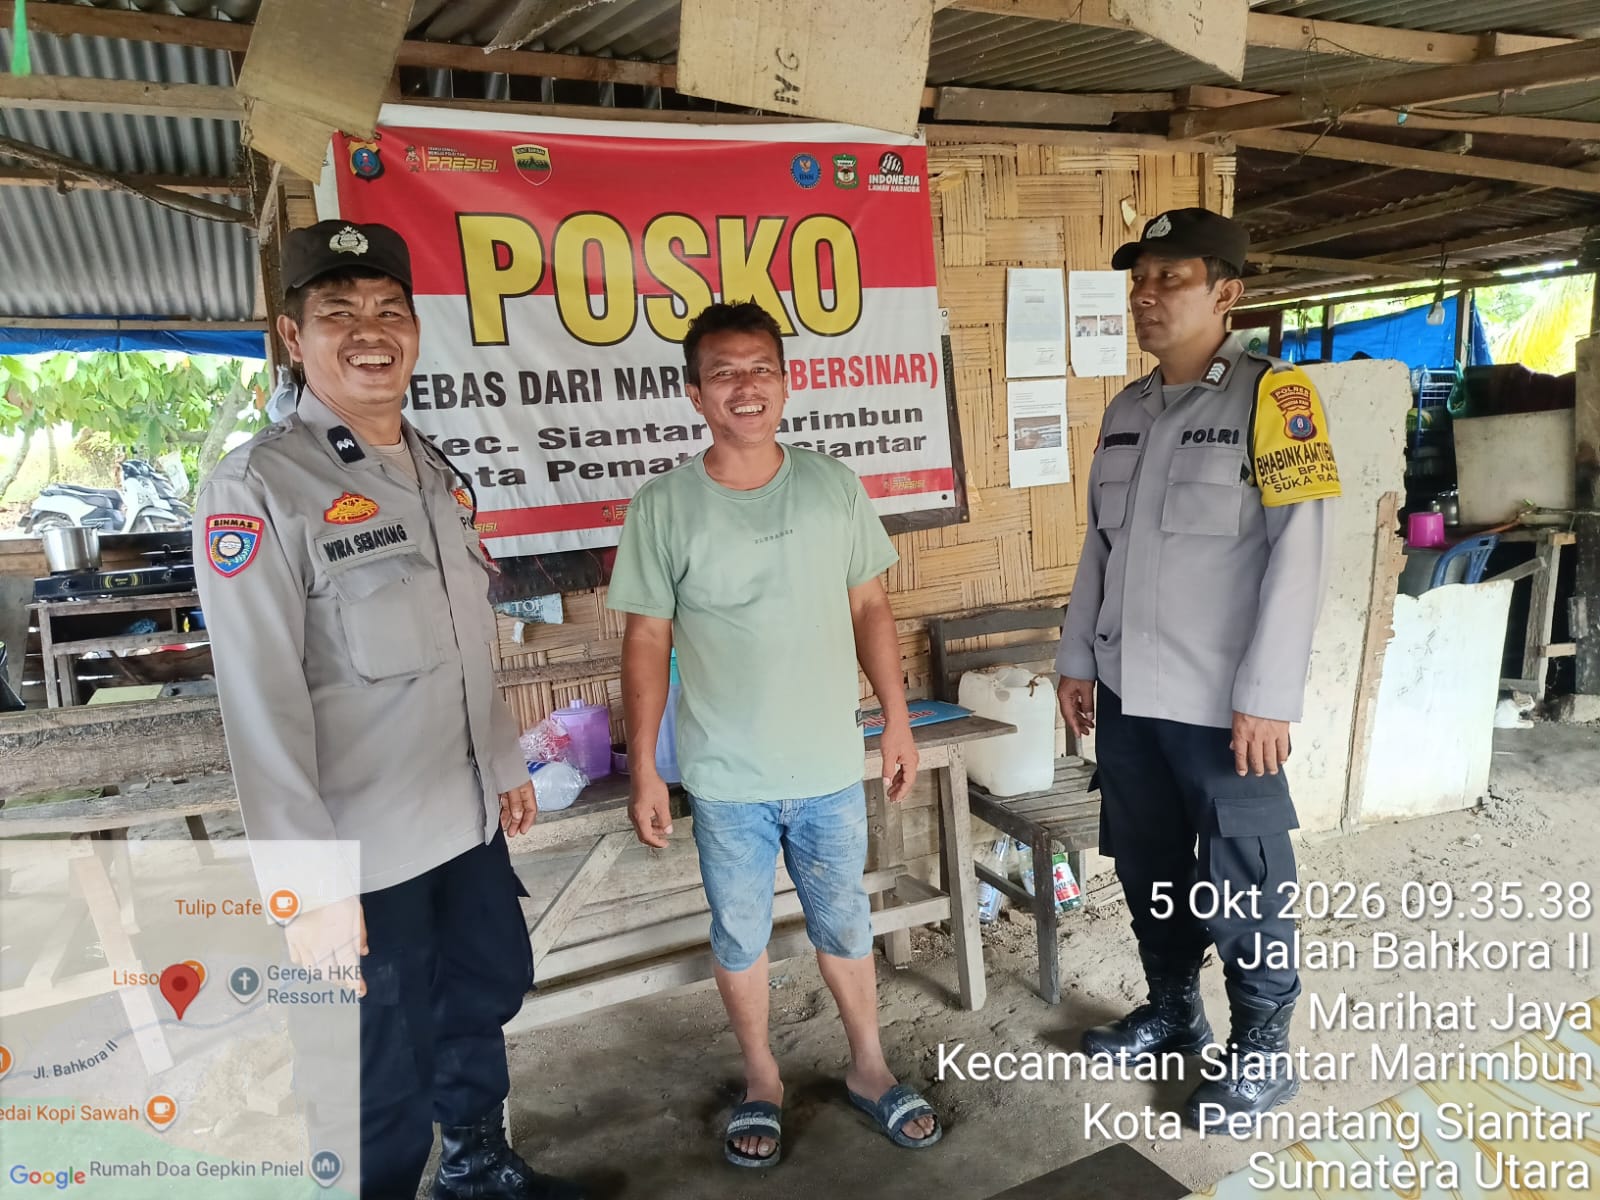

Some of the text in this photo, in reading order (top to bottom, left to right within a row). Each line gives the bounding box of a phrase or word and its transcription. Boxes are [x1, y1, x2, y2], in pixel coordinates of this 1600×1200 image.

[427, 156, 497, 169] PRESISI
[868, 174, 920, 185] INDONESIA
[455, 210, 863, 347] POSKO
[518, 368, 603, 406] DARI
[614, 365, 689, 401] NAR
[789, 352, 938, 391] BERSINAR)
[426, 407, 923, 456] ec. Siantar arimbun
[1181, 428, 1239, 445] POLRI
[546, 452, 692, 482] Pemat
[1261, 472, 1291, 487] KEL.
[1274, 476, 1312, 493] SUKA
[213, 519, 253, 528] BINMAS
[323, 537, 355, 562] WIRA
